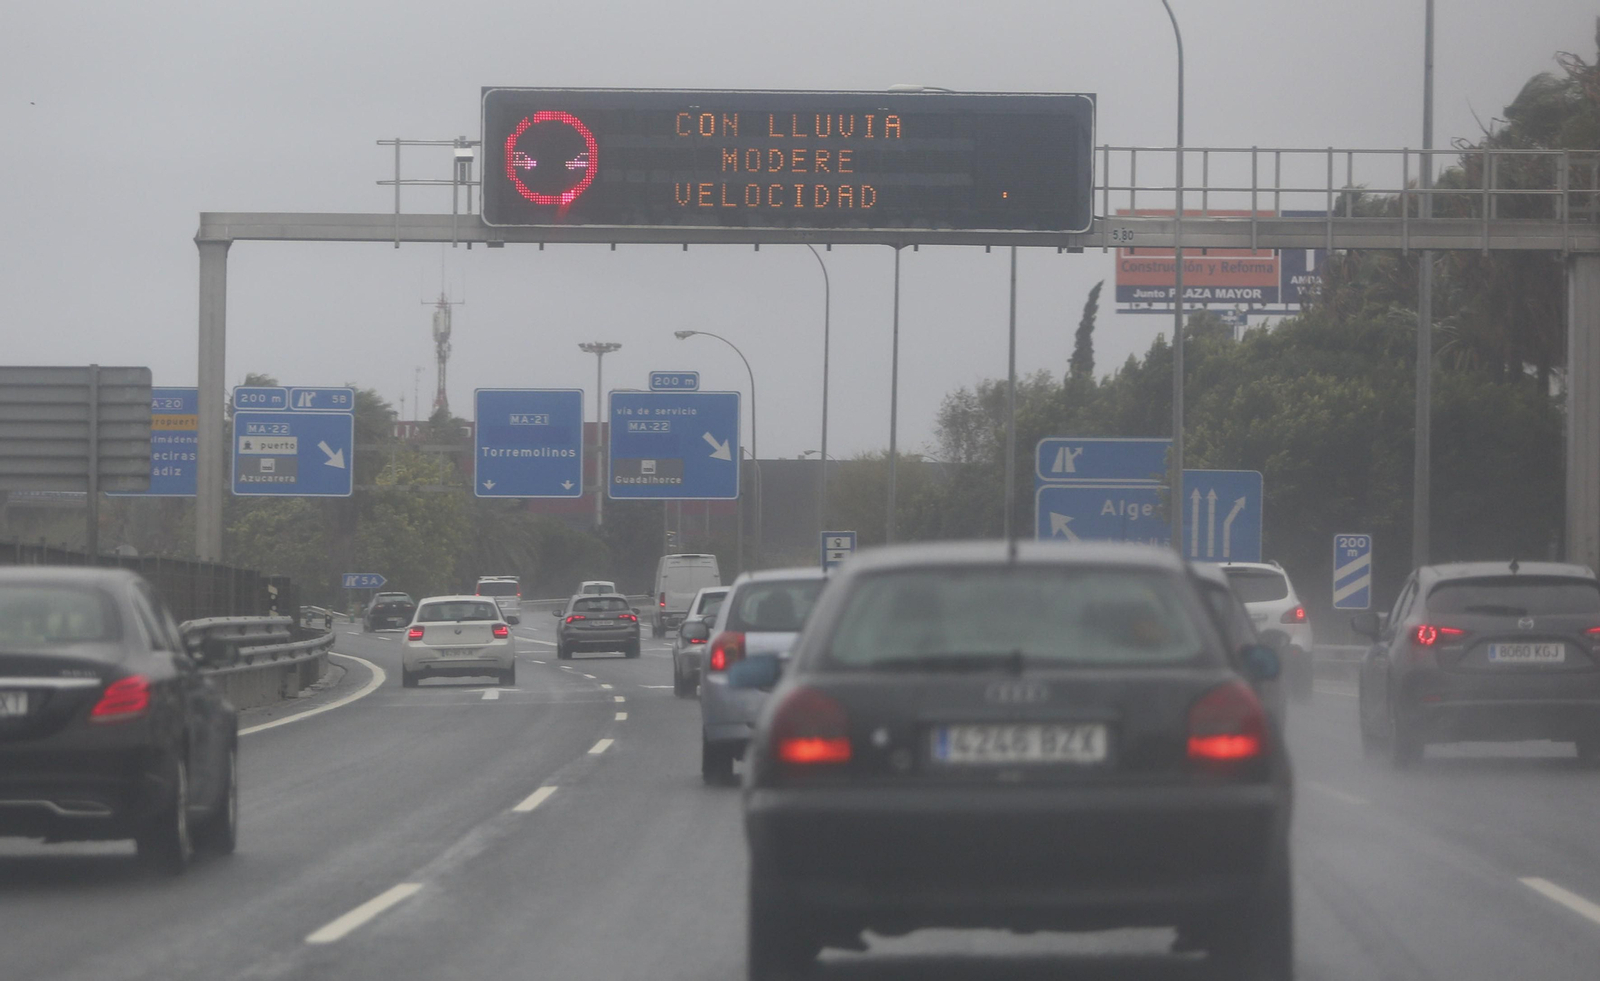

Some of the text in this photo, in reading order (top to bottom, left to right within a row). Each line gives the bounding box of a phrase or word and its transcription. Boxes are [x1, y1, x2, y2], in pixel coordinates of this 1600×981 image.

[676, 112, 901, 139] CON LLUVIA
[721, 147, 854, 173] MODERE
[675, 182, 877, 209] VELOCIDAD
[1208, 263, 1216, 275] y
[1221, 261, 1274, 274] Reforma
[1133, 288, 1262, 299] Junto PAZA MAYOR
[654, 376, 695, 386] 200 m
[241, 393, 266, 403] 200
[271, 395, 282, 403] m
[151, 399, 182, 409] A-20
[637, 406, 650, 416] de
[655, 406, 698, 416] servicio
[510, 415, 548, 424] MA-21
[247, 424, 289, 434] MA-22
[628, 422, 669, 431] MA-22
[260, 441, 296, 452] puerto
[152, 451, 197, 461] eciras
[481, 446, 576, 458] Torremolinos
[153, 466, 182, 476] ádiz
[239, 474, 296, 483] Azucarera
[615, 475, 682, 485] Guadalhorce
[1100, 499, 1163, 521] Alge
[1339, 537, 1366, 548] 200
[1347, 549, 1358, 557] m
[1499, 645, 1559, 658] 8060 KGJ
